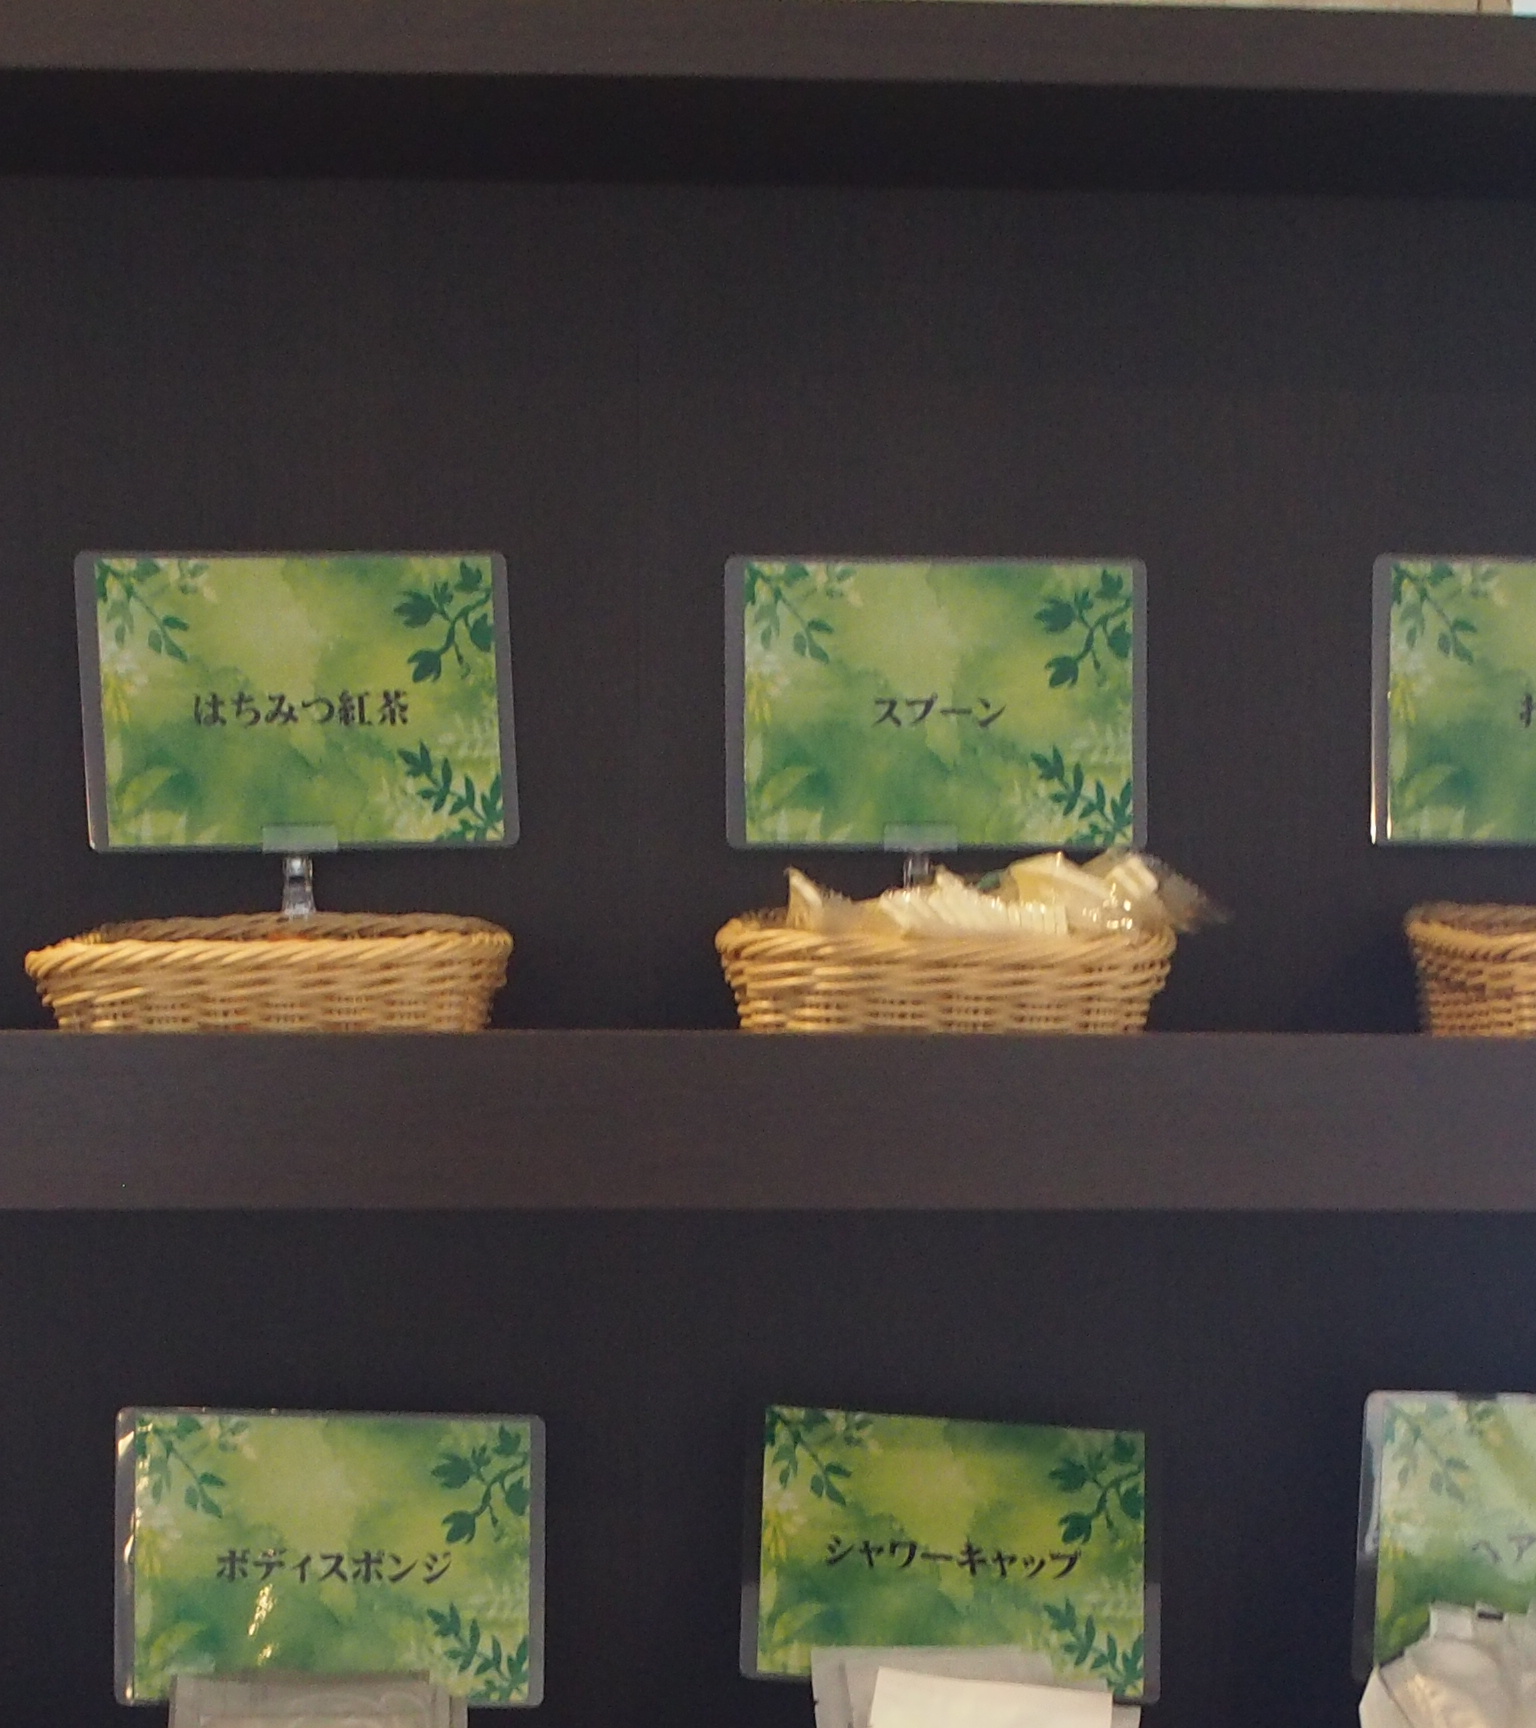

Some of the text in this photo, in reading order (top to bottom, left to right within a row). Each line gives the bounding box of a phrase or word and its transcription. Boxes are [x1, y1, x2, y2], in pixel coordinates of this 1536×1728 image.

[193, 690, 412, 729] はちみつ紅茶
[873, 692, 1010, 729] スプーン
[216, 1547, 453, 1585] ボディスポンジ
[822, 1533, 1084, 1580] シャワーキャップ
